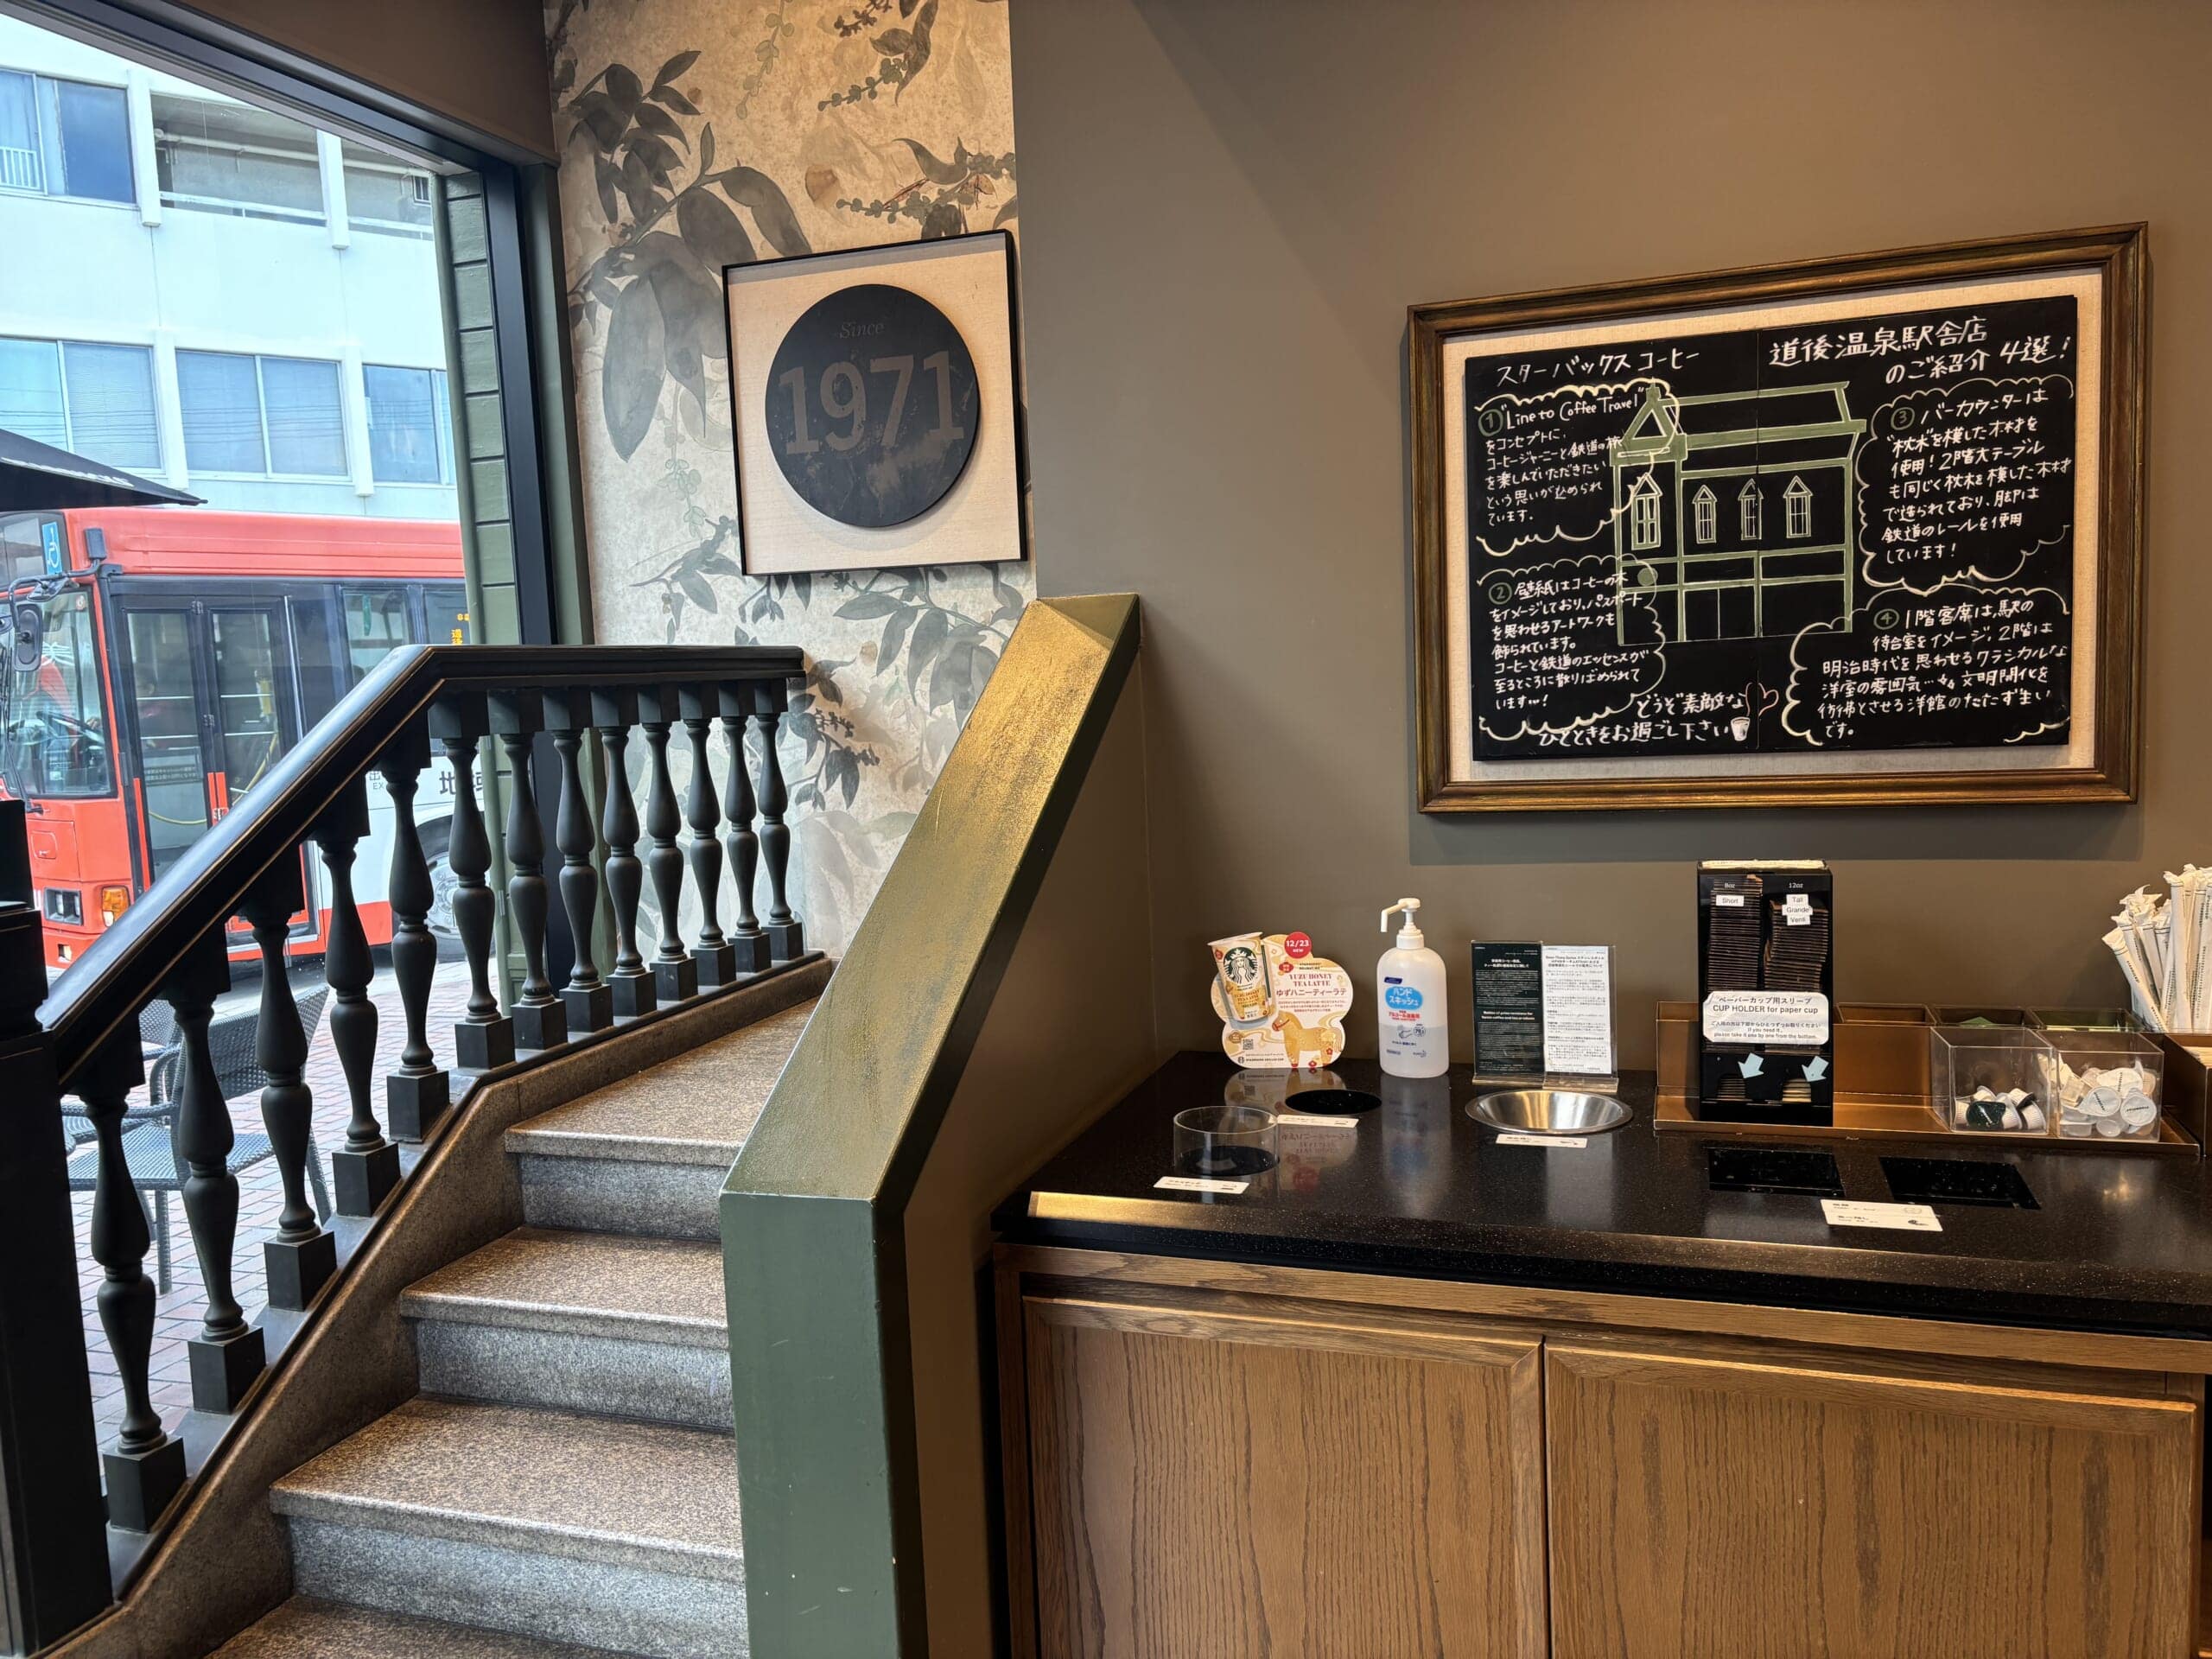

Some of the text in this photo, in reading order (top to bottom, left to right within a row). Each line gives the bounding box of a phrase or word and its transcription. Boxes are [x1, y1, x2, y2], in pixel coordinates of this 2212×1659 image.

[839, 321, 885, 339] Since
[1769, 316, 1988, 366] 道後温泉駅舎店
[779, 351, 964, 454] 1971
[1560, 401, 1597, 421] Coffee
[1484, 461, 1606, 491] を楽しんでいただきたい
[1487, 482, 1603, 508] という思いが込められ
[1881, 512, 2022, 543] 鉄道のレールを使用
[1822, 645, 2067, 677] 明治時代を思わせるクラシカルな
[1637, 692, 1744, 719] どうぞ素敵な
[1539, 719, 1728, 747] ひとときをお過ごし下さい
[1394, 988, 1413, 996] ハンド
